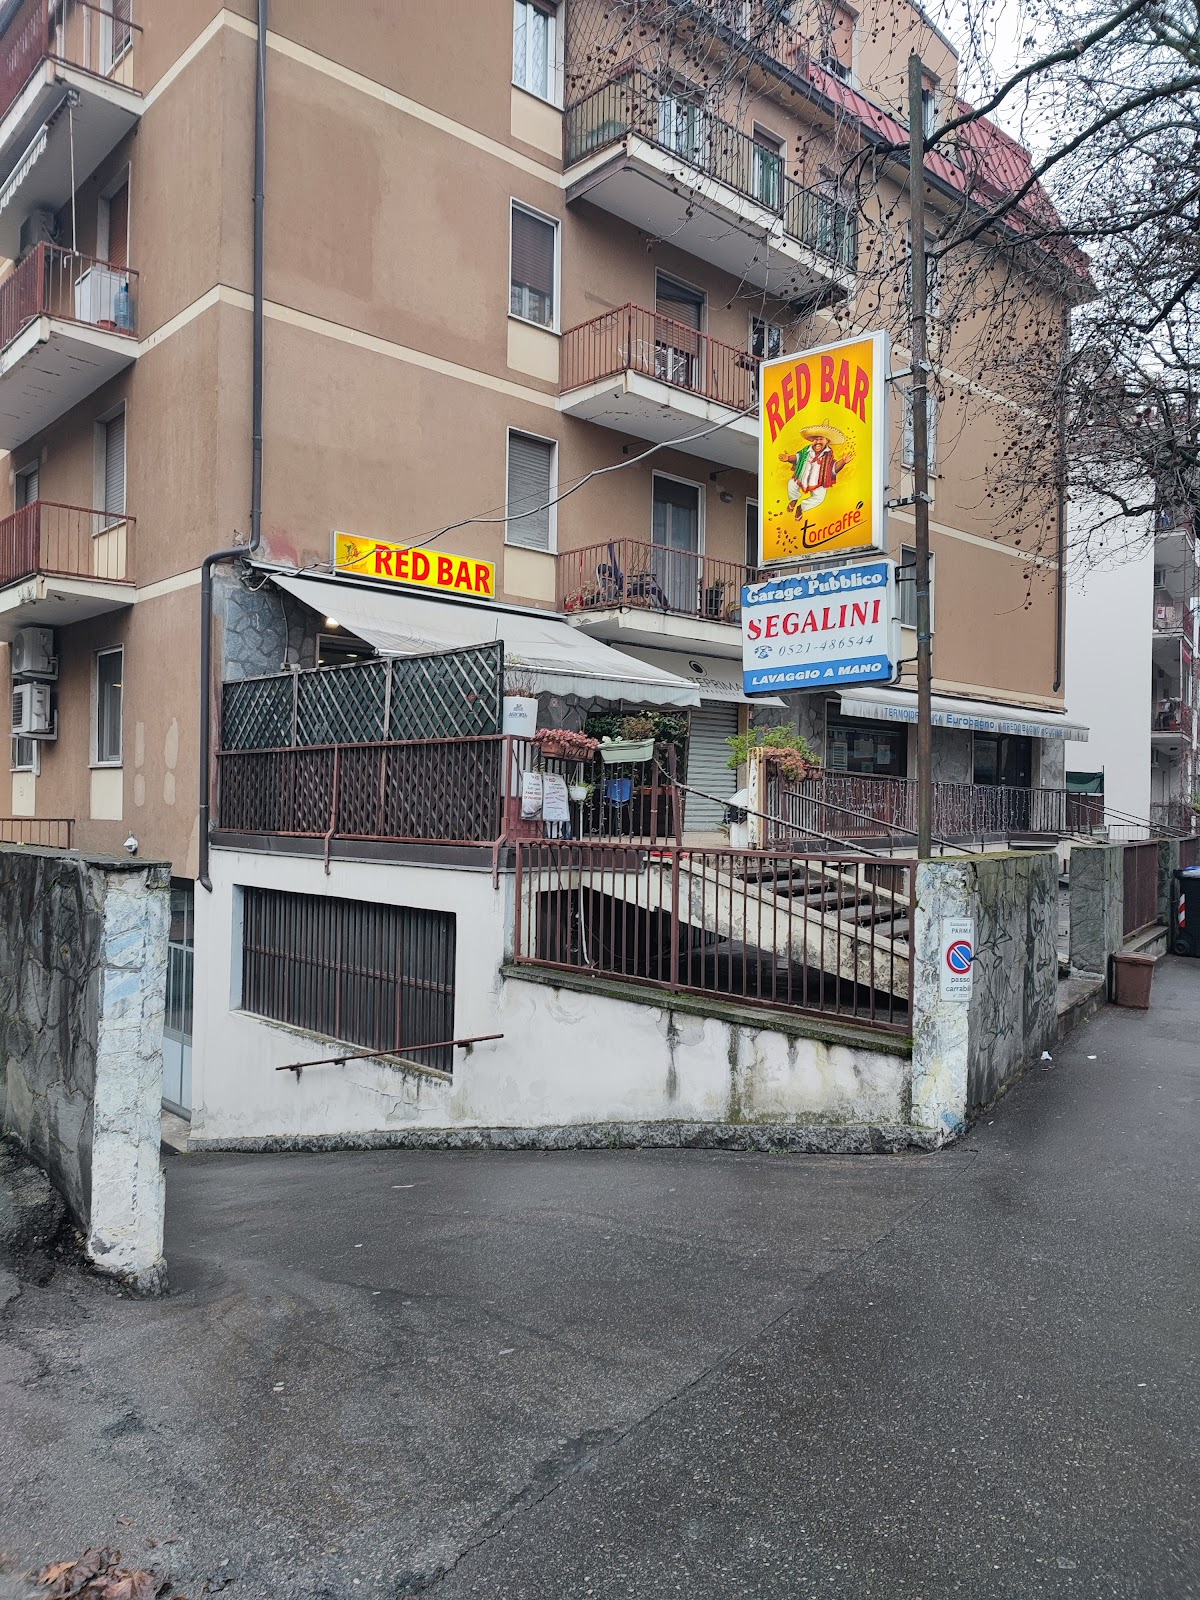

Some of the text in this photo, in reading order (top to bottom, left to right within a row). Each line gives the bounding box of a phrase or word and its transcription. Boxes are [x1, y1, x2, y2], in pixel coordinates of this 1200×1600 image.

[766, 356, 869, 443] RED BAR
[375, 544, 491, 593] RED BAR
[747, 573, 882, 603] Garage Pubblico
[747, 600, 881, 640] SEGALINI
[778, 634, 873, 657] 0521-486544
[752, 663, 882, 686] LAVAGGIO A MANO
[946, 713, 995, 731] Eurobagno
